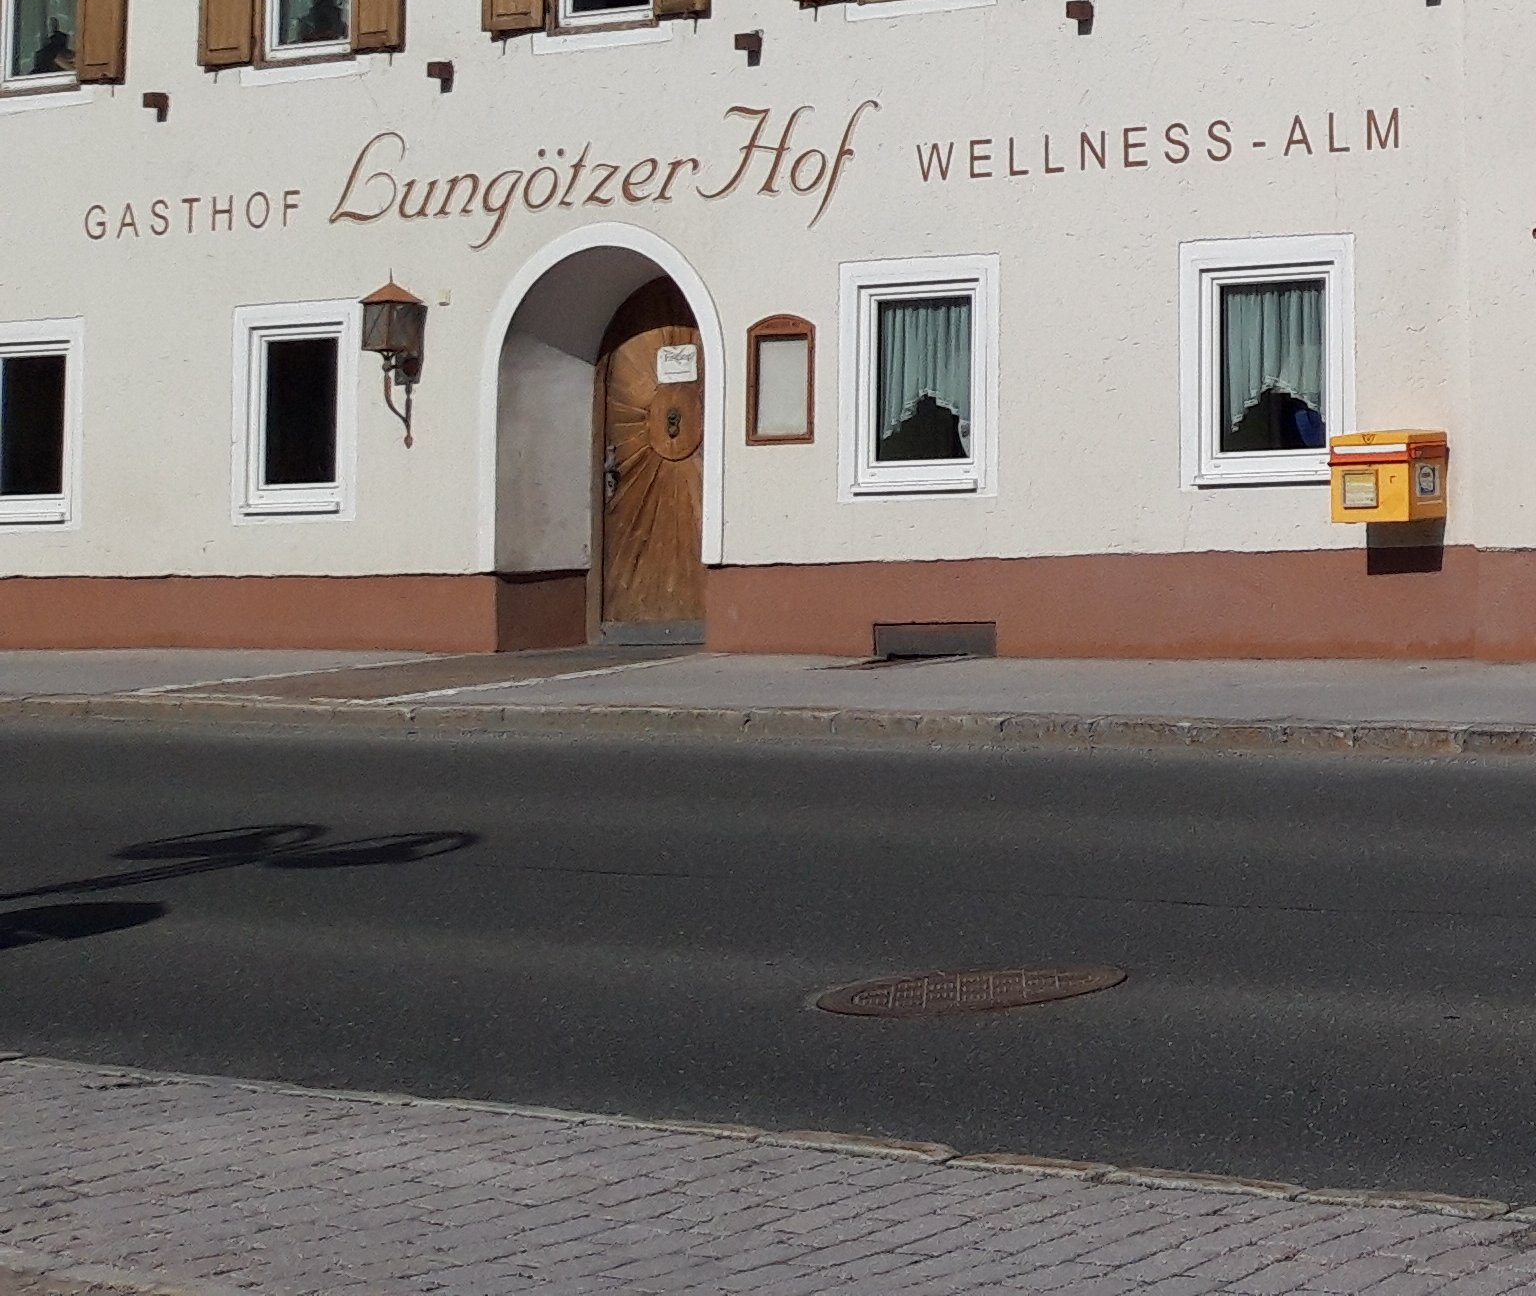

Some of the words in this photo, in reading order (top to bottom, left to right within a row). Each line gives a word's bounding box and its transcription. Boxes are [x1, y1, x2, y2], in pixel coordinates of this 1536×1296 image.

[84, 189, 301, 241] GASTHOF
[328, 131, 700, 252] Lungötzer
[695, 99, 882, 230] Hof
[915, 106, 1401, 182] WELLNESS-ALM
